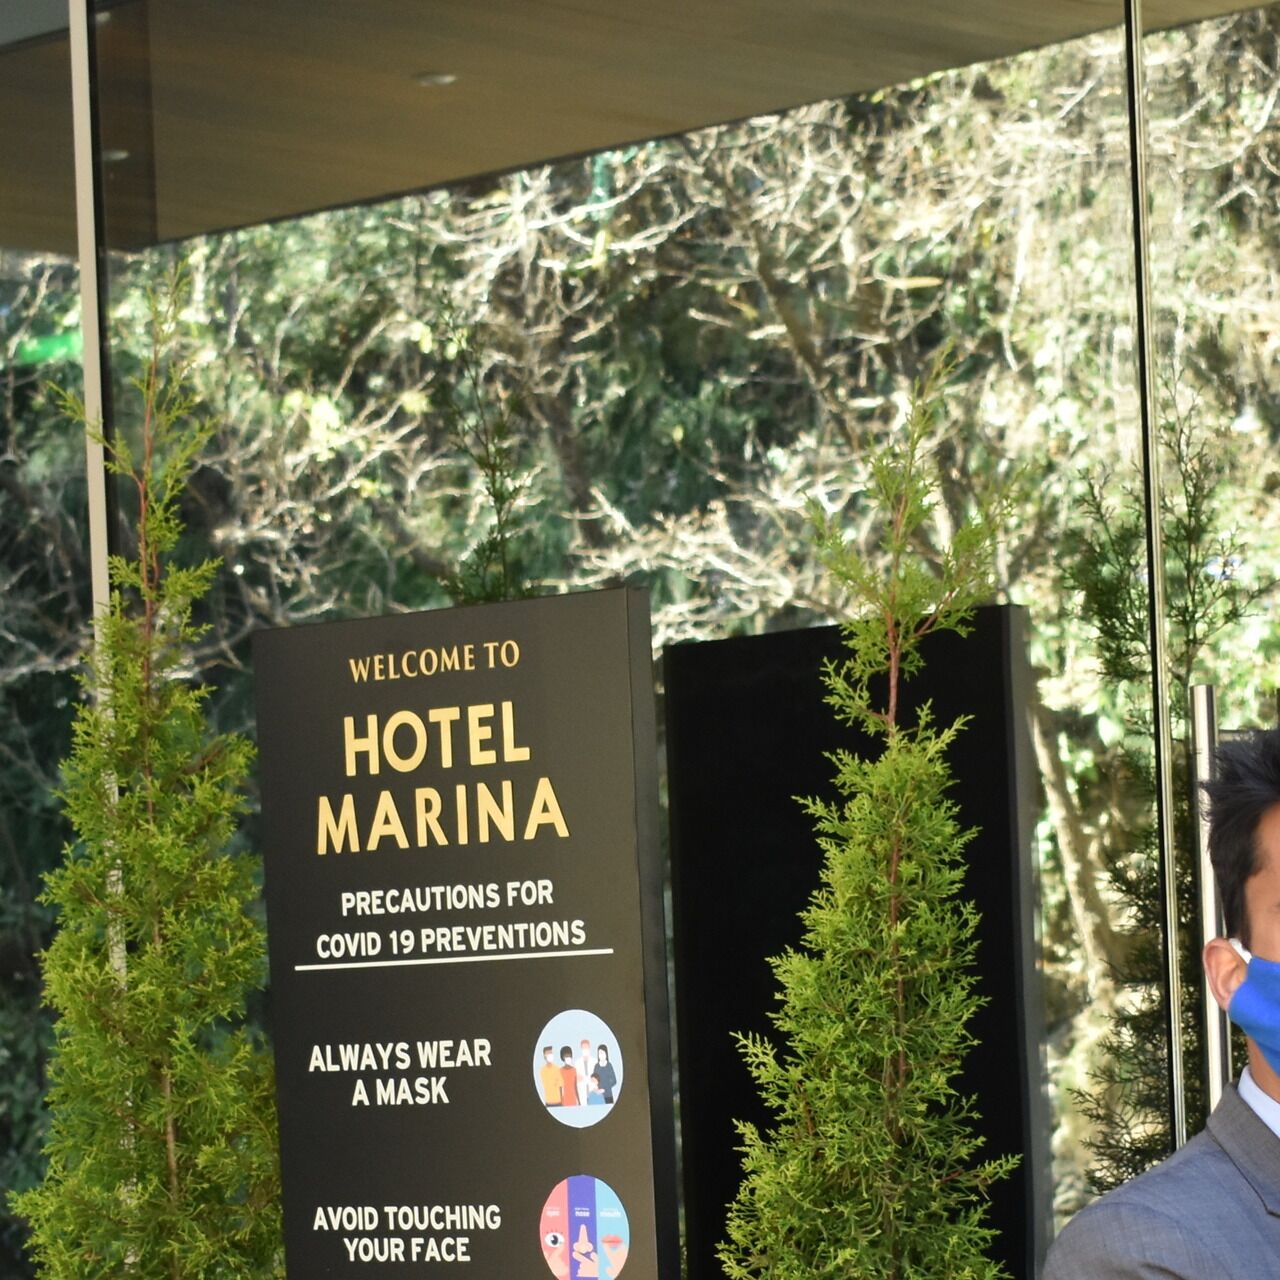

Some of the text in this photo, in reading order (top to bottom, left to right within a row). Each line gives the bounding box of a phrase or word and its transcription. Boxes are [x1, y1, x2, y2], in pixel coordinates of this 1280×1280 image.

[349, 640, 520, 683] WELCOME TO
[343, 700, 531, 777] HOTEL
[317, 777, 570, 855] MARINA
[341, 879, 554, 917] PRECAUTIONS FOR
[316, 919, 588, 959] COVID 19 PREVENTIONS
[308, 1038, 492, 1072] ALWAYS WEAR
[351, 1076, 450, 1106] A MASK
[313, 1204, 502, 1231] AVOID TOUCHING
[343, 1236, 471, 1262] YOUR FACE
